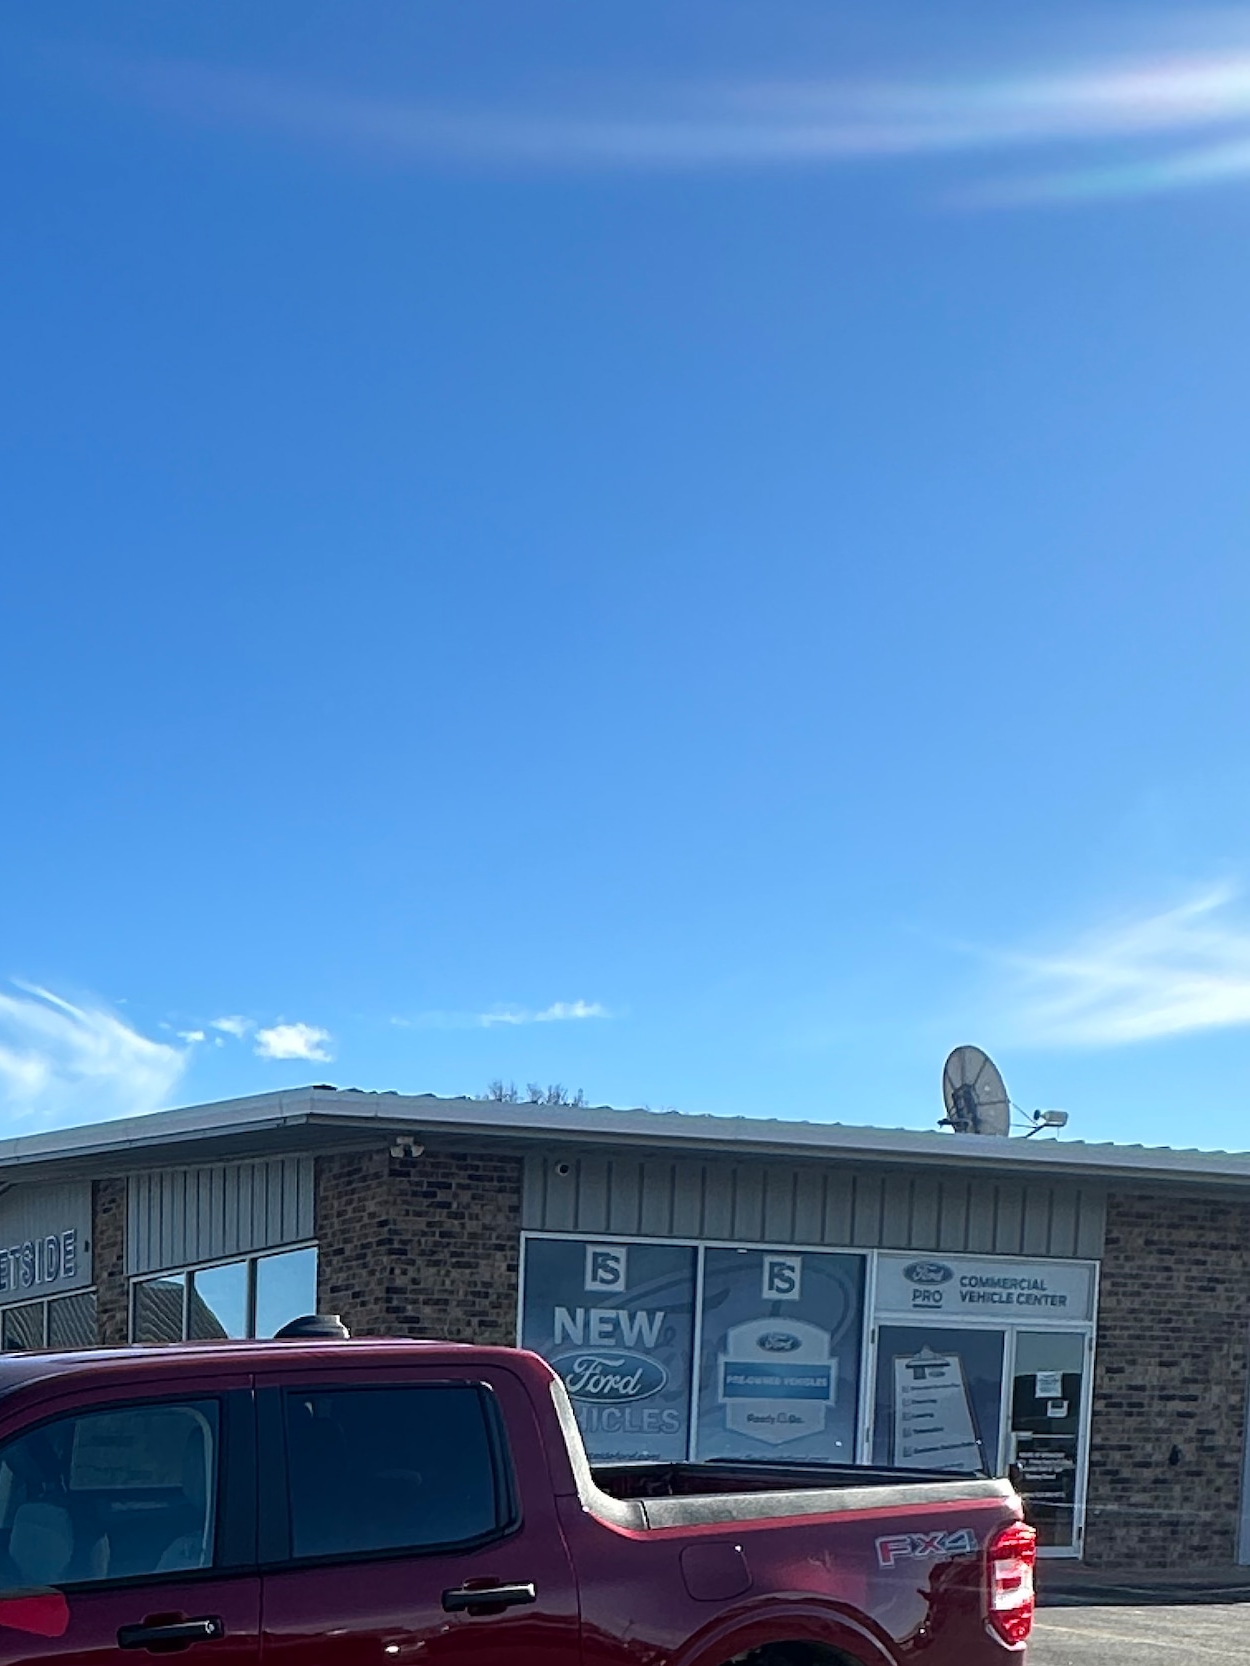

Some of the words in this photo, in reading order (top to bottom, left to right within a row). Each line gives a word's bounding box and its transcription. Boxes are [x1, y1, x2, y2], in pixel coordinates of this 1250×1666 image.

[912, 1288, 943, 1302] PRO
[959, 1275, 1047, 1291] COMMERCIAL
[960, 1290, 1013, 1304] VEHICLE
[1016, 1292, 1068, 1307] CENTER
[554, 1306, 665, 1348] NEW
[565, 1355, 643, 1395] Ford
[874, 1528, 979, 1569] FX4
